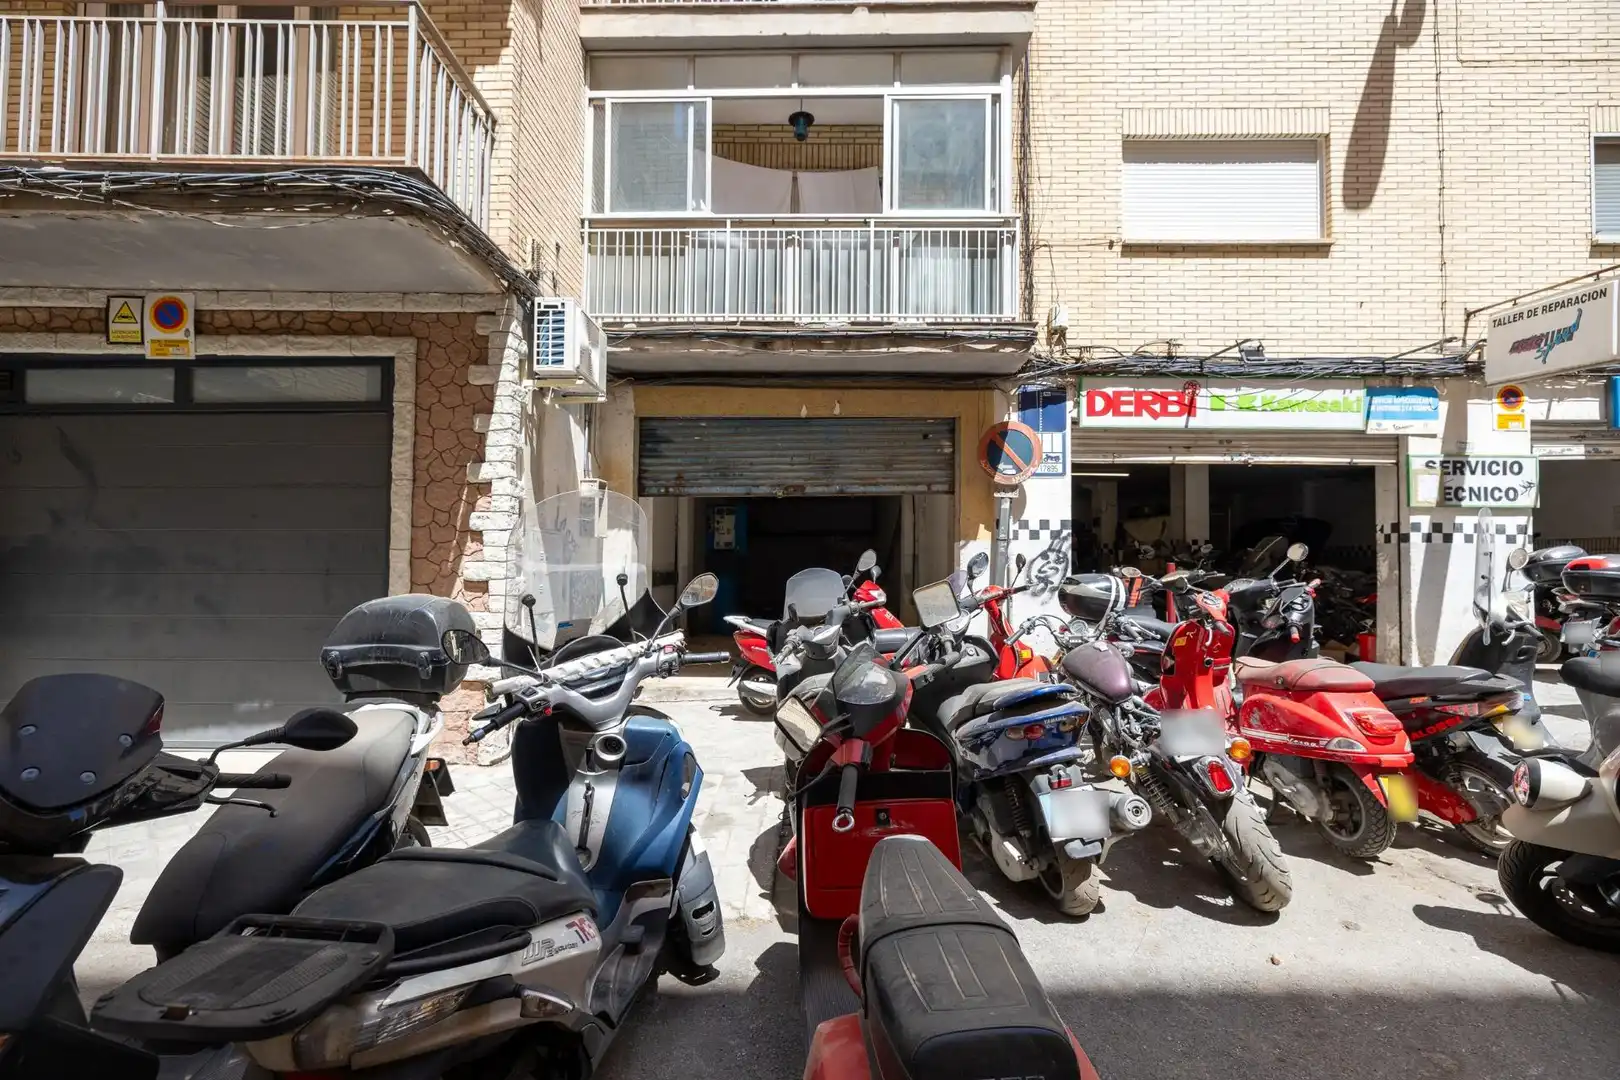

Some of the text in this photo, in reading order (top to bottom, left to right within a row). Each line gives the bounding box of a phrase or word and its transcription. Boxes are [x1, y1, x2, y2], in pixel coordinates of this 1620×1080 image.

[1492, 288, 1607, 328] TALLER DE REPARACION
[1086, 389, 1196, 420] DERBI
[1261, 394, 1362, 413] Kawasaki
[1425, 460, 1523, 476] SERVICIO
